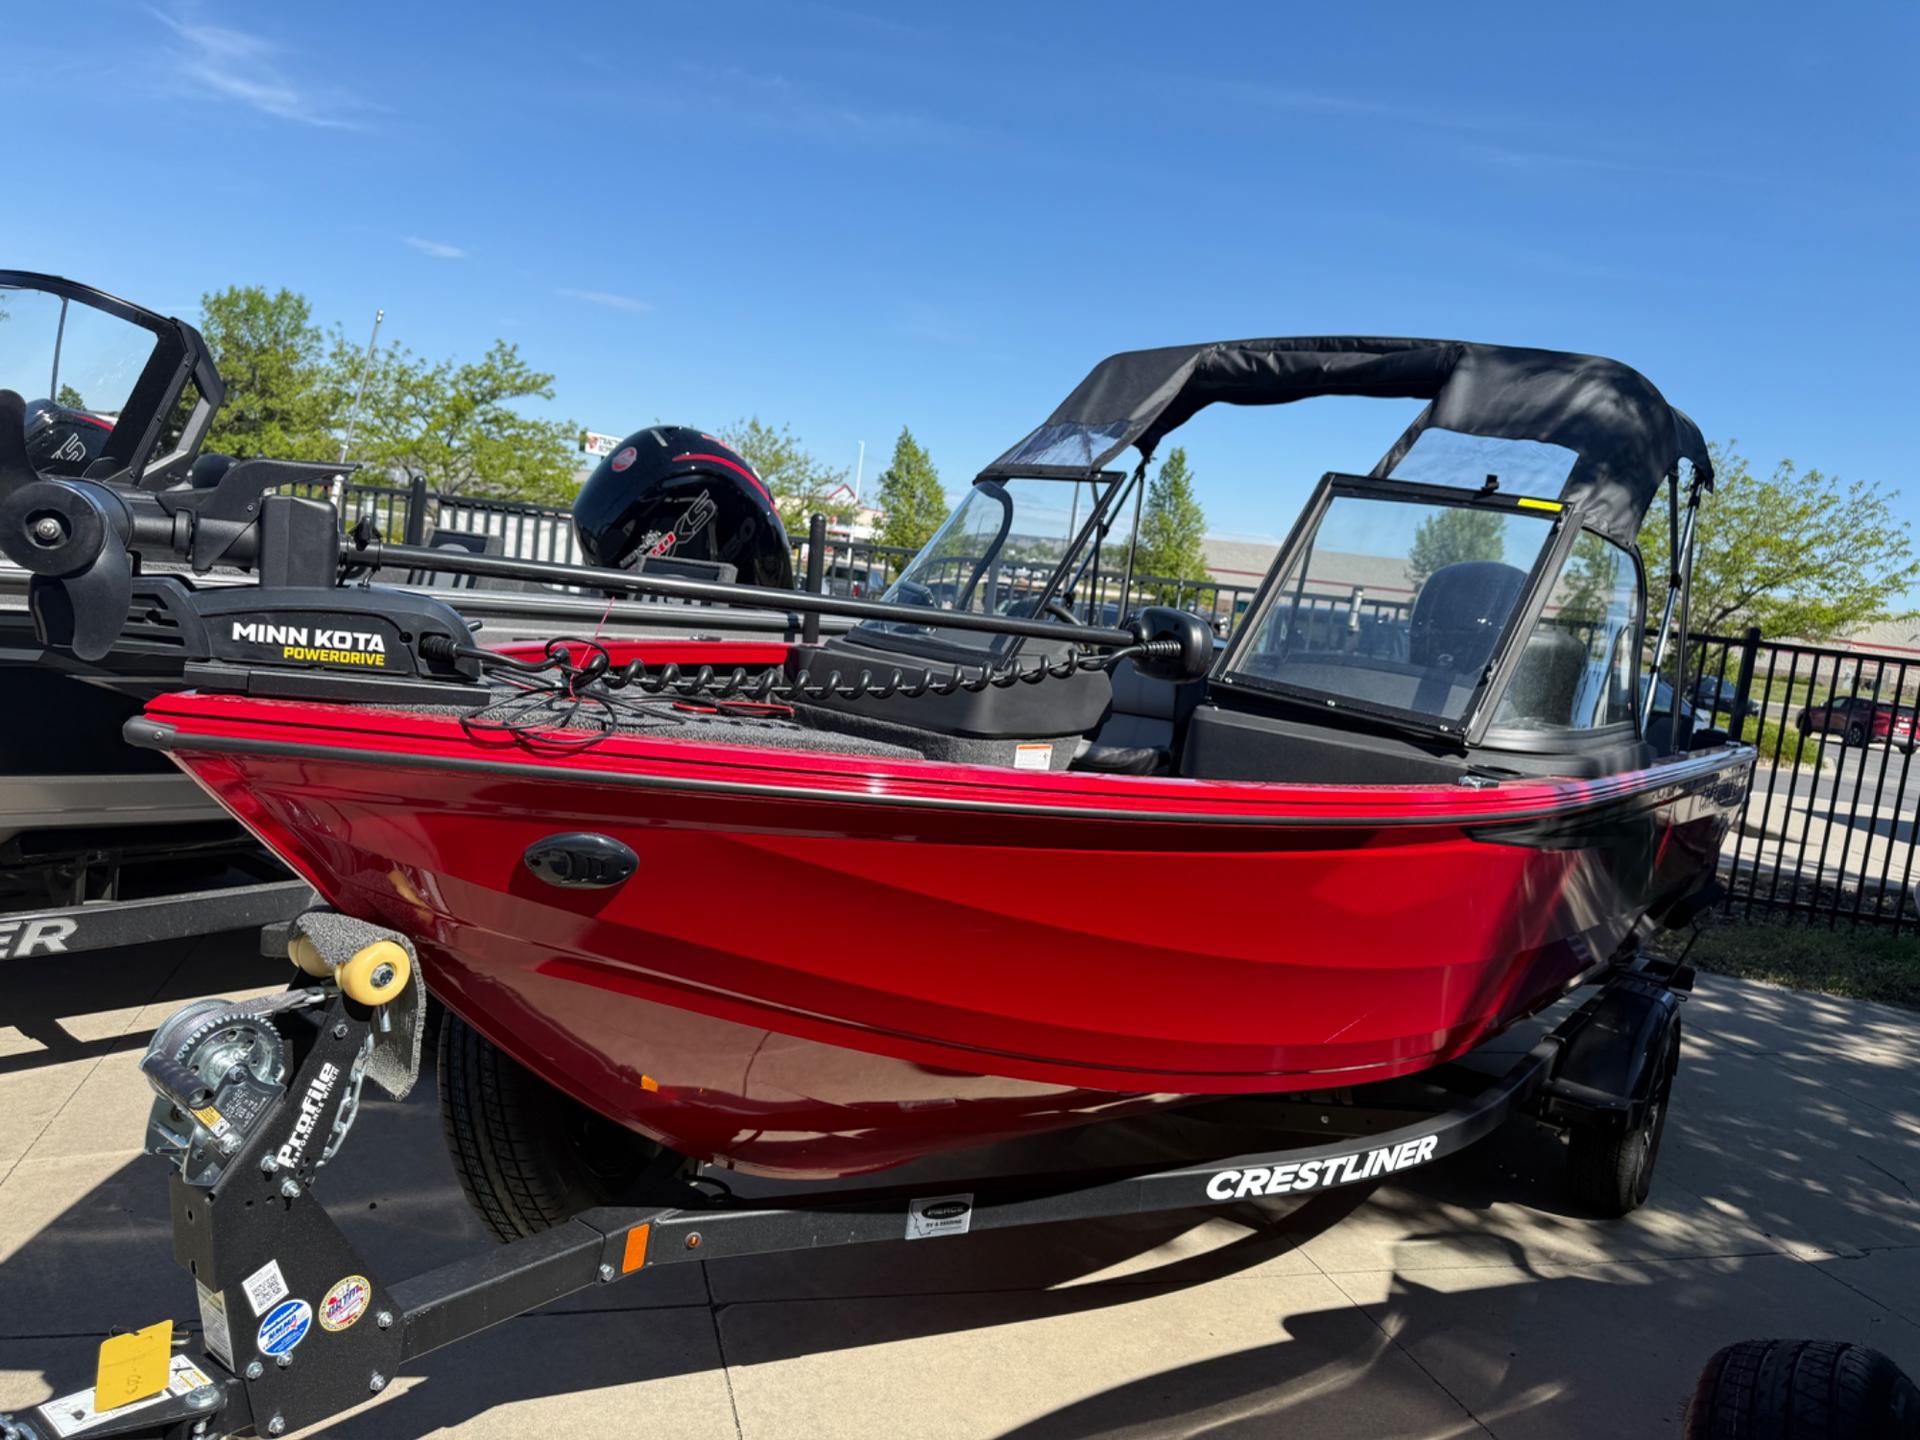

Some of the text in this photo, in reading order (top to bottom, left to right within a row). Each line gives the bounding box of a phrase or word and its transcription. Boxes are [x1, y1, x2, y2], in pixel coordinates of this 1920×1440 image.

[51, 432, 86, 462] S
[232, 622, 385, 653] MINN KOTA
[283, 646, 385, 666] POWERDRIVE
[276, 1062, 332, 1168] Profile
[290, 1066, 340, 1168] PERFORMANCE WINCH
[1205, 1134, 1439, 1201] CRESTLINER
